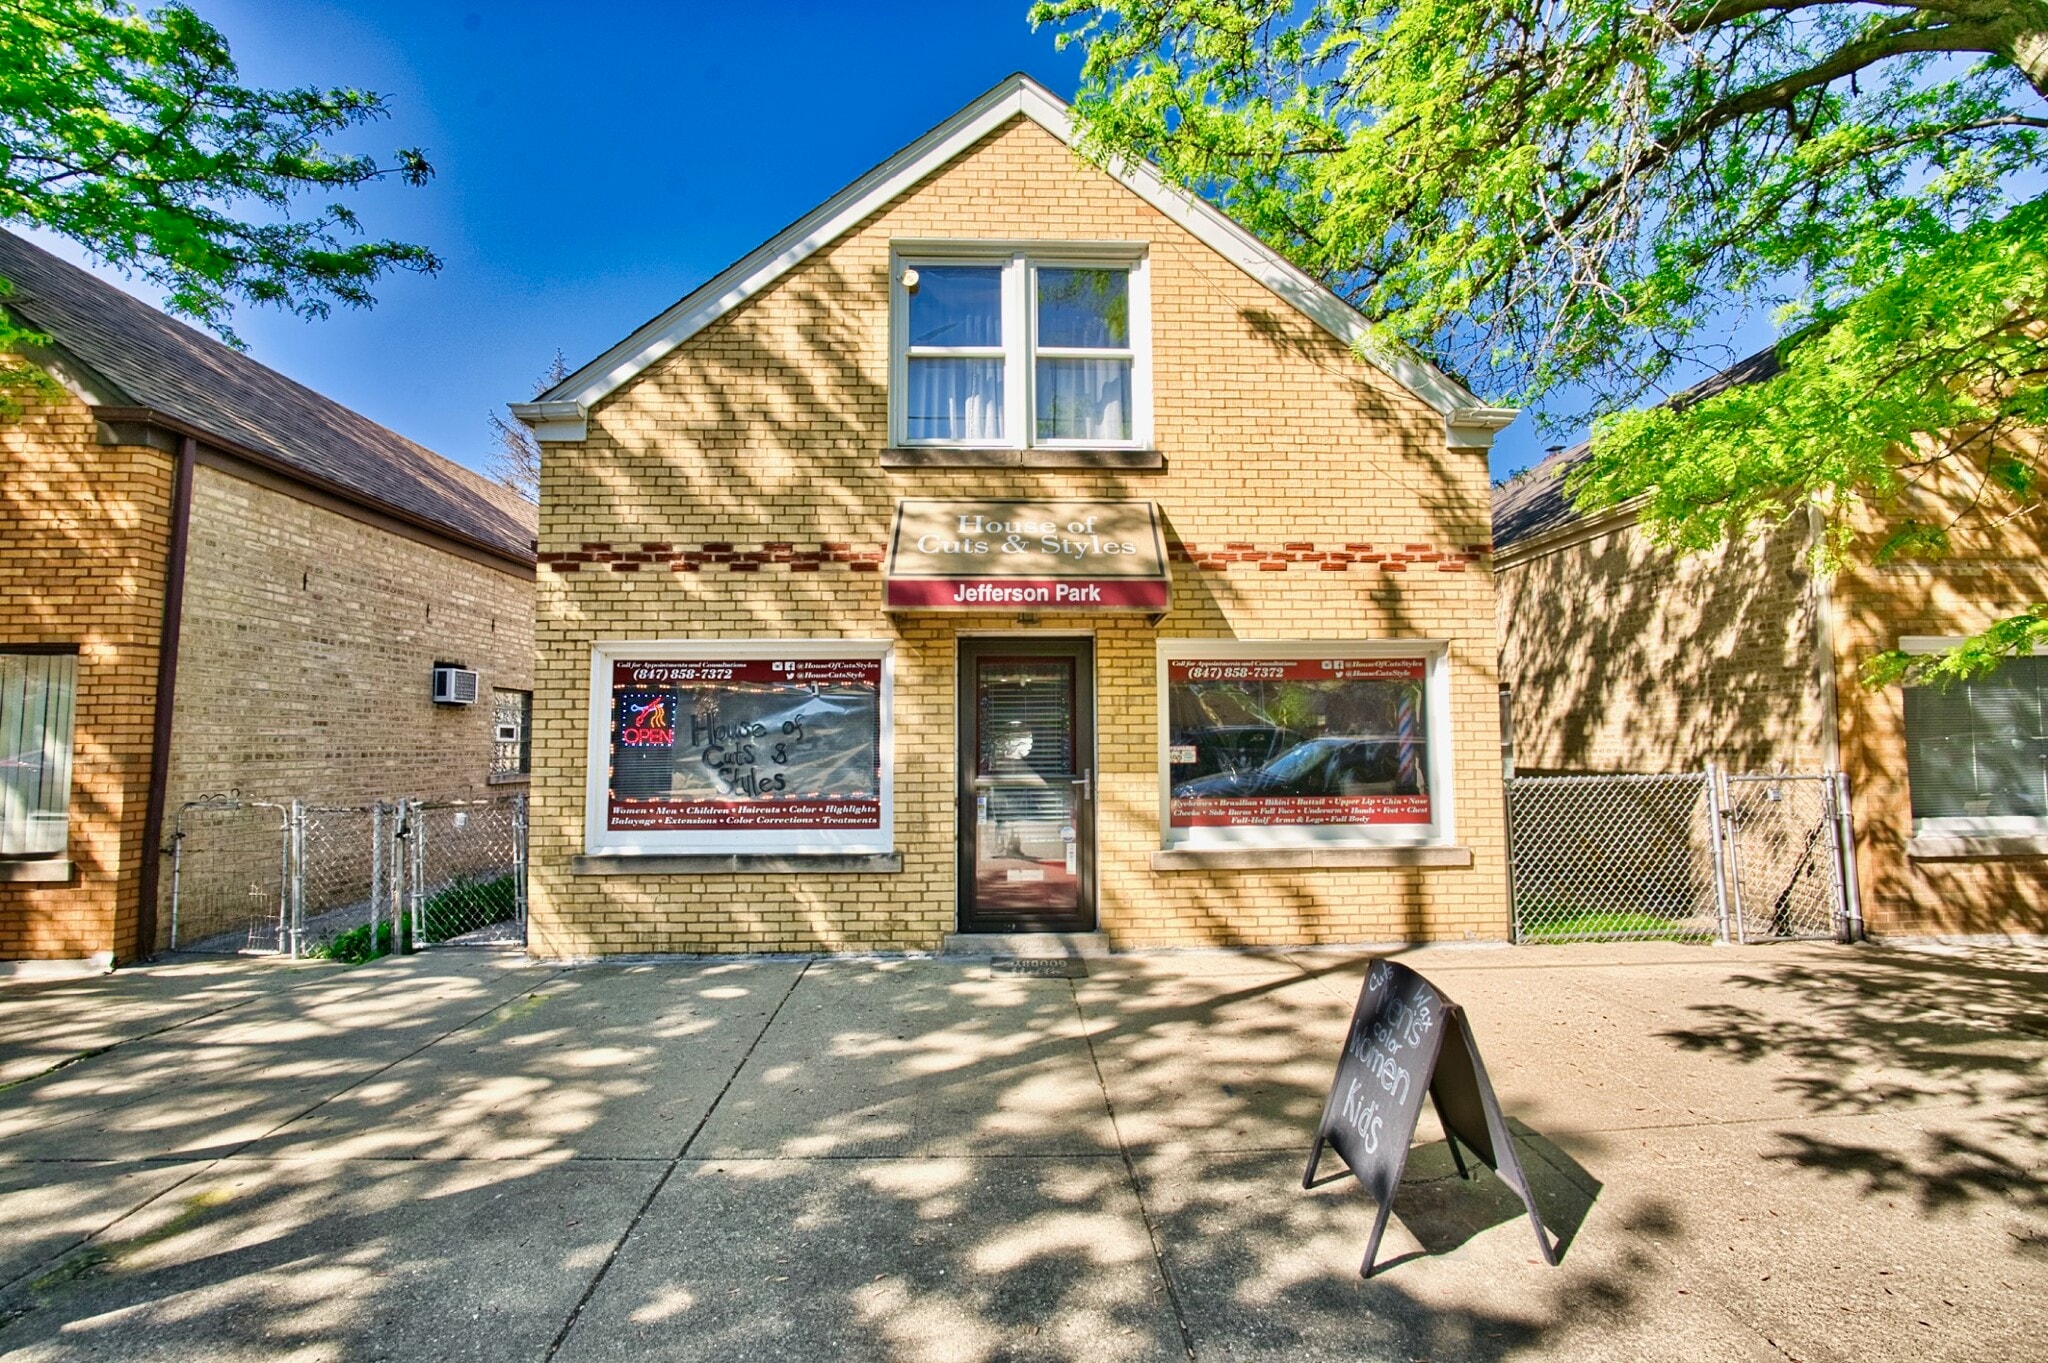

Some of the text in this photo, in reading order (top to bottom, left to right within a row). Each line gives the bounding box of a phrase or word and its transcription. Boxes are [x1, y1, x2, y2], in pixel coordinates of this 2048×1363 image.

[957, 515, 1097, 534] House of
[917, 534, 1137, 559] Cuts & Styles
[953, 583, 1101, 602] Jefferson Park
[796, 662, 879, 670] @HouseOfCutsStyles
[1188, 667, 1284, 679] (847) 858-7372
[633, 668, 733, 681] (847) 858-7372
[796, 672, 866, 680] @HouseCutsStyle
[623, 729, 673, 744] OPEN
[691, 713, 804, 747] House of
[702, 742, 755, 769] Cuts
[719, 767, 786, 797] Styles
[1265, 798, 1290, 806] Bikini
[1334, 798, 1360, 806] Upper
[1361, 798, 1375, 806] Lip
[1382, 797, 1401, 805] Chin
[612, 805, 876, 815] Women Men Children Haircuts Color Highlights
[1173, 809, 1200, 817] Cheeks
[1228, 808, 1252, 816] Burns
[611, 817, 656, 826] Balayage
[756, 816, 813, 824] Corrections
[822, 816, 877, 824] Treatments
[1231, 816, 1271, 825] Full-Half
[1273, 816, 1295, 824] Arms
[1305, 816, 1324, 824] Legs
[1349, 815, 1370, 824] Body
[1369, 963, 1394, 992] Cuts
[1413, 983, 1433, 1034] Wax
